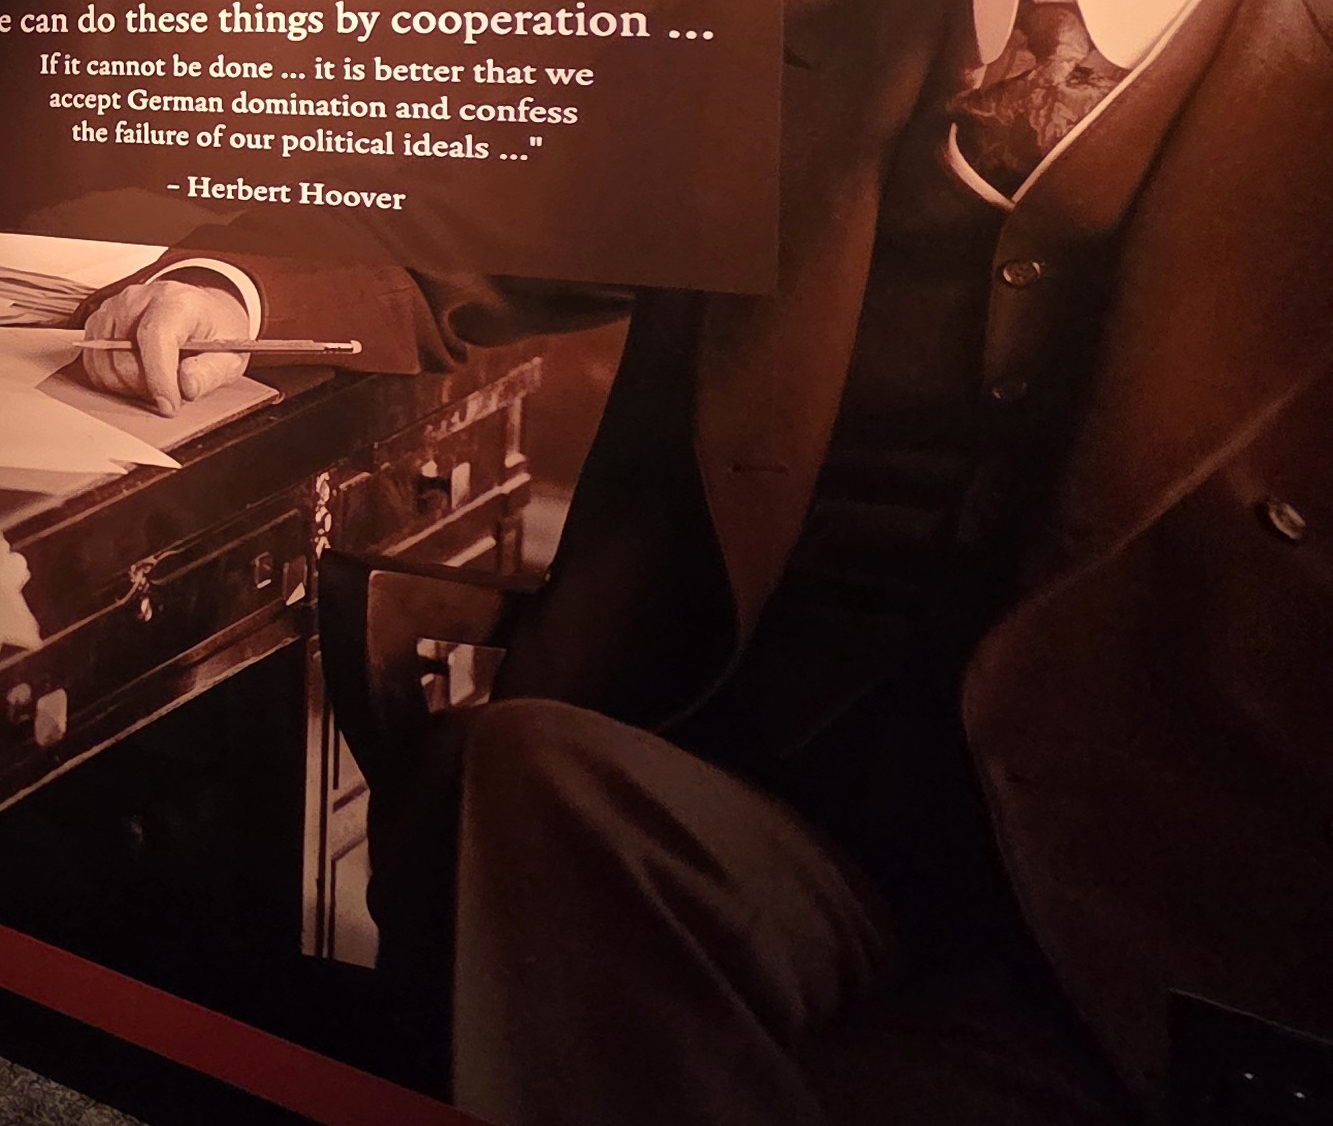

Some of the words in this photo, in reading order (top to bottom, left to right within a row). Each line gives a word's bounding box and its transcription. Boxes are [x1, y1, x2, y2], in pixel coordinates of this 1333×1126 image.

[20, 12, 69, 34] can
[77, 4, 117, 34] do
[126, 3, 209, 34] these
[218, 2, 324, 42] things
[335, 1, 381, 42] by
[391, 2, 651, 45] cooperation
[187, 176, 291, 204] Herbert
[299, 182, 407, 211] Hoover
